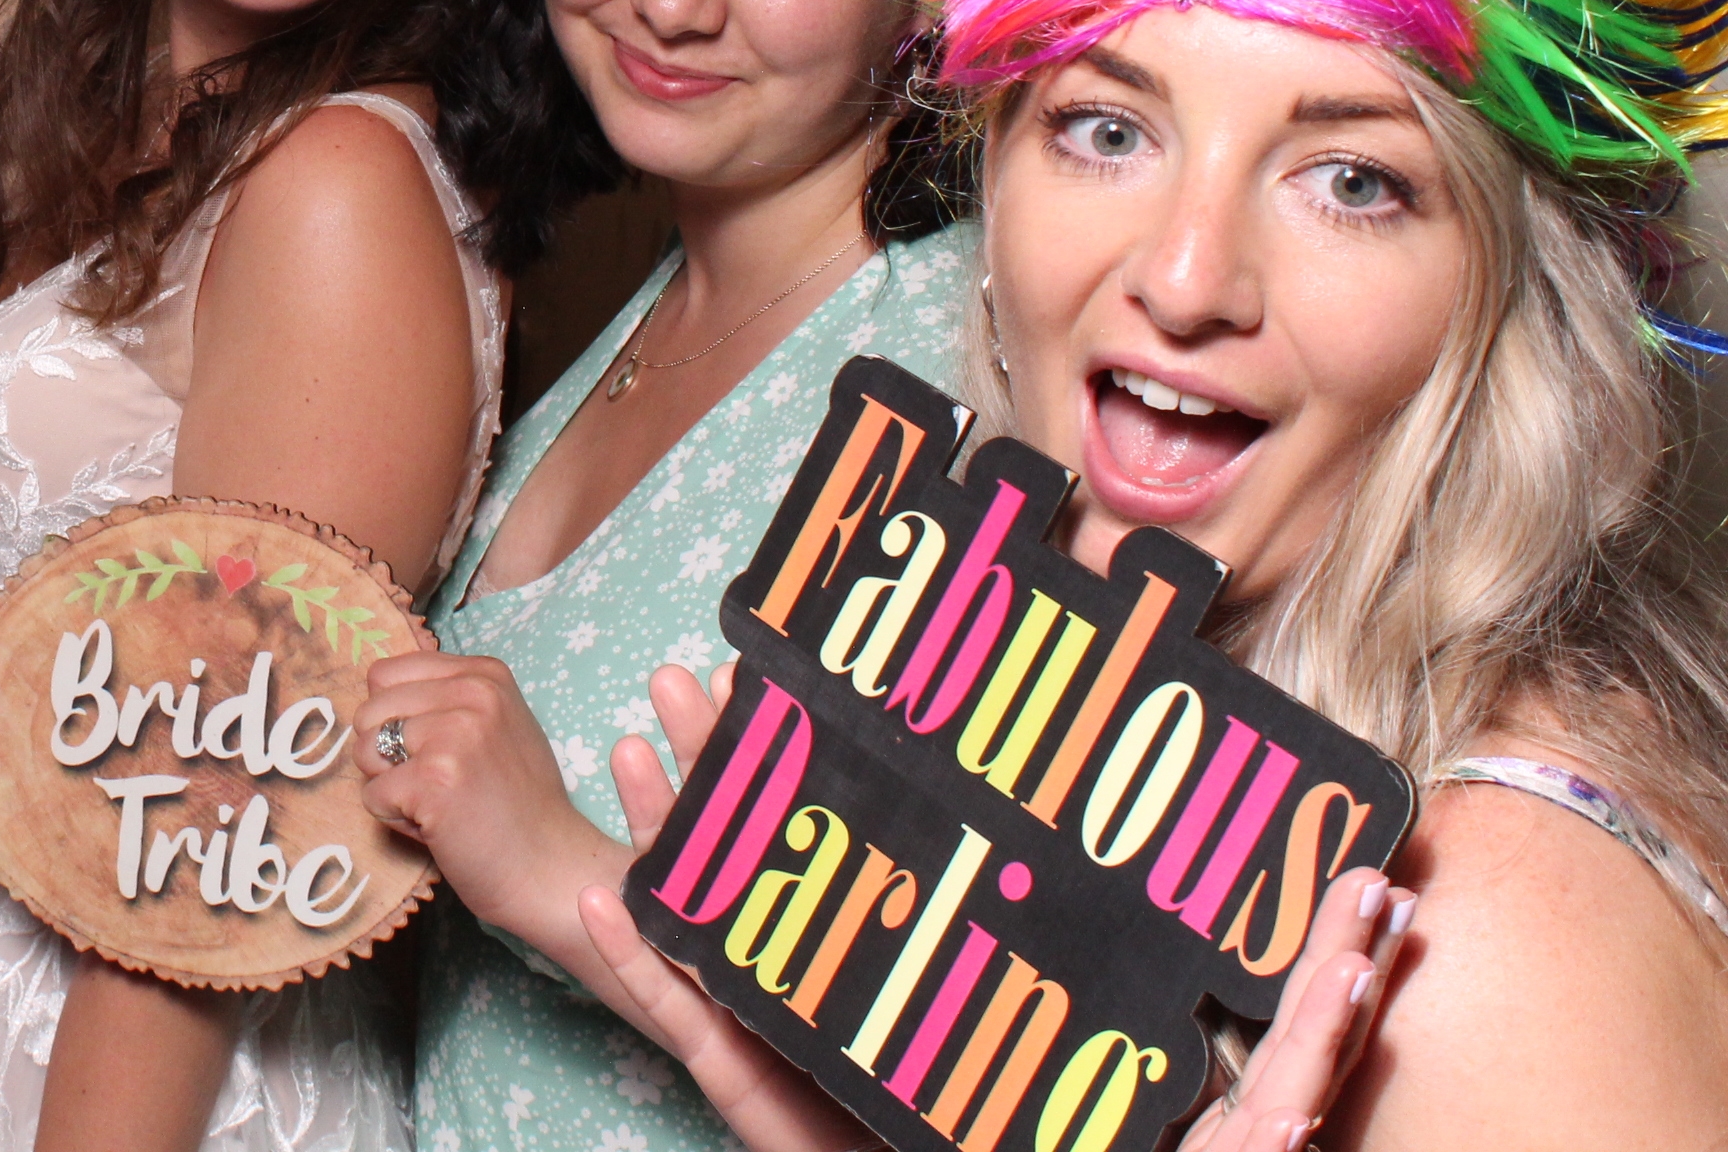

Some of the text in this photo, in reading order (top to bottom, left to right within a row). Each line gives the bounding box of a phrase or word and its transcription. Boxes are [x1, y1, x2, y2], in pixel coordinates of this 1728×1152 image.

[51, 619, 353, 779] Bride
[749, 393, 1372, 976] Fabulous
[94, 775, 370, 928] Tribe
